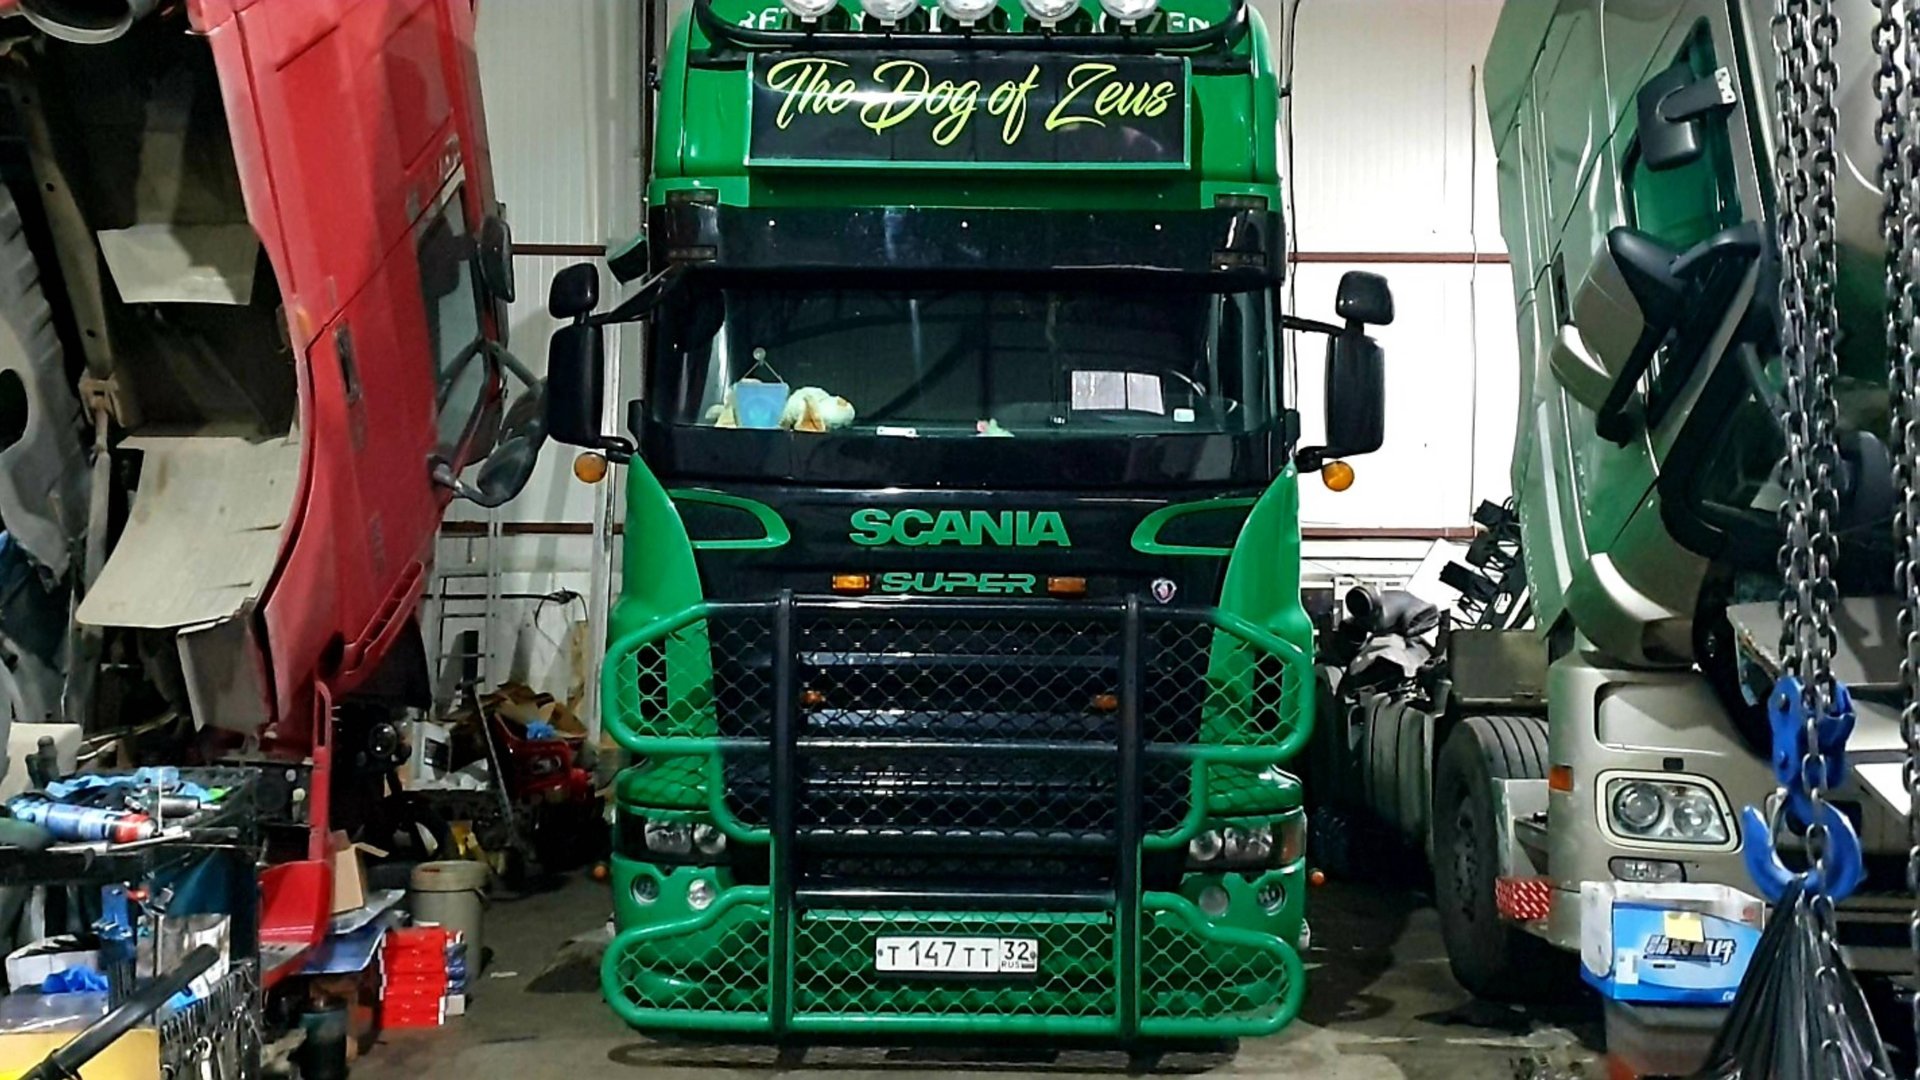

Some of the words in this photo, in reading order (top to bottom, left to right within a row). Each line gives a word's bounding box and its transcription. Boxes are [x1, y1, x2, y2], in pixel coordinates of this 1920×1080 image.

[767, 57, 855, 129] The
[860, 60, 980, 146] Dog
[987, 64, 1040, 145] of
[1045, 63, 1177, 131] Zeus
[849, 508, 1072, 546] SCANIA
[881, 572, 1036, 594] SUPER
[1004, 941, 1029, 961] 32
[1001, 960, 1020, 969] RUS
